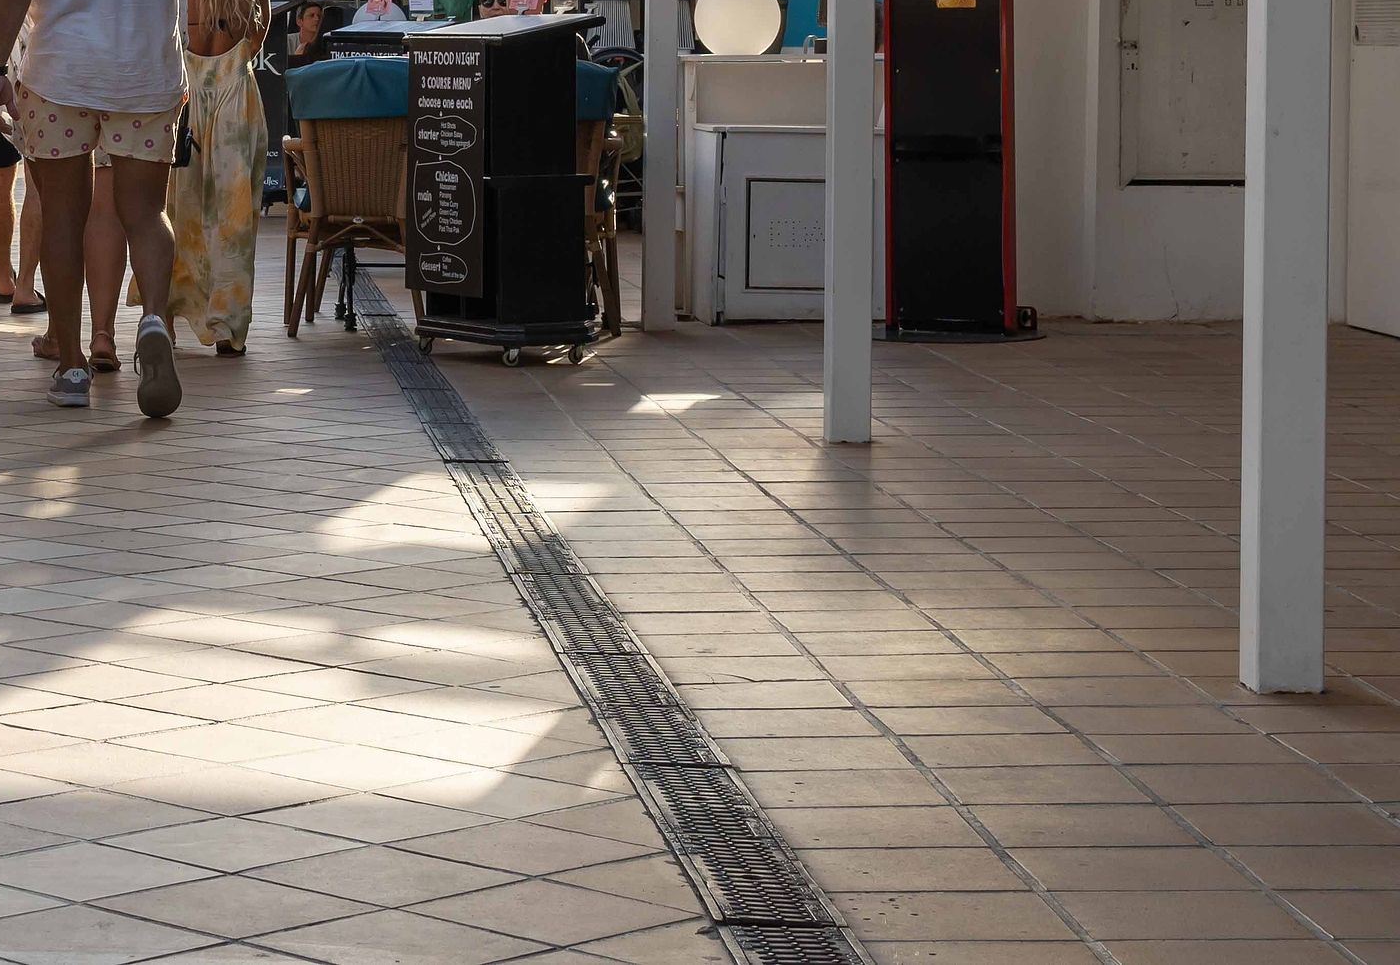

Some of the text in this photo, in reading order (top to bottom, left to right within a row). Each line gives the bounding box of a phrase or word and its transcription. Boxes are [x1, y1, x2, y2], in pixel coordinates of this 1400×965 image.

[413, 50, 481, 66] THAI FOOD NIGHT
[421, 76, 426, 89] 3
[427, 76, 451, 90] COURSE
[452, 77, 472, 90] MENU
[418, 95, 473, 110] choose one each
[418, 128, 439, 140] starter
